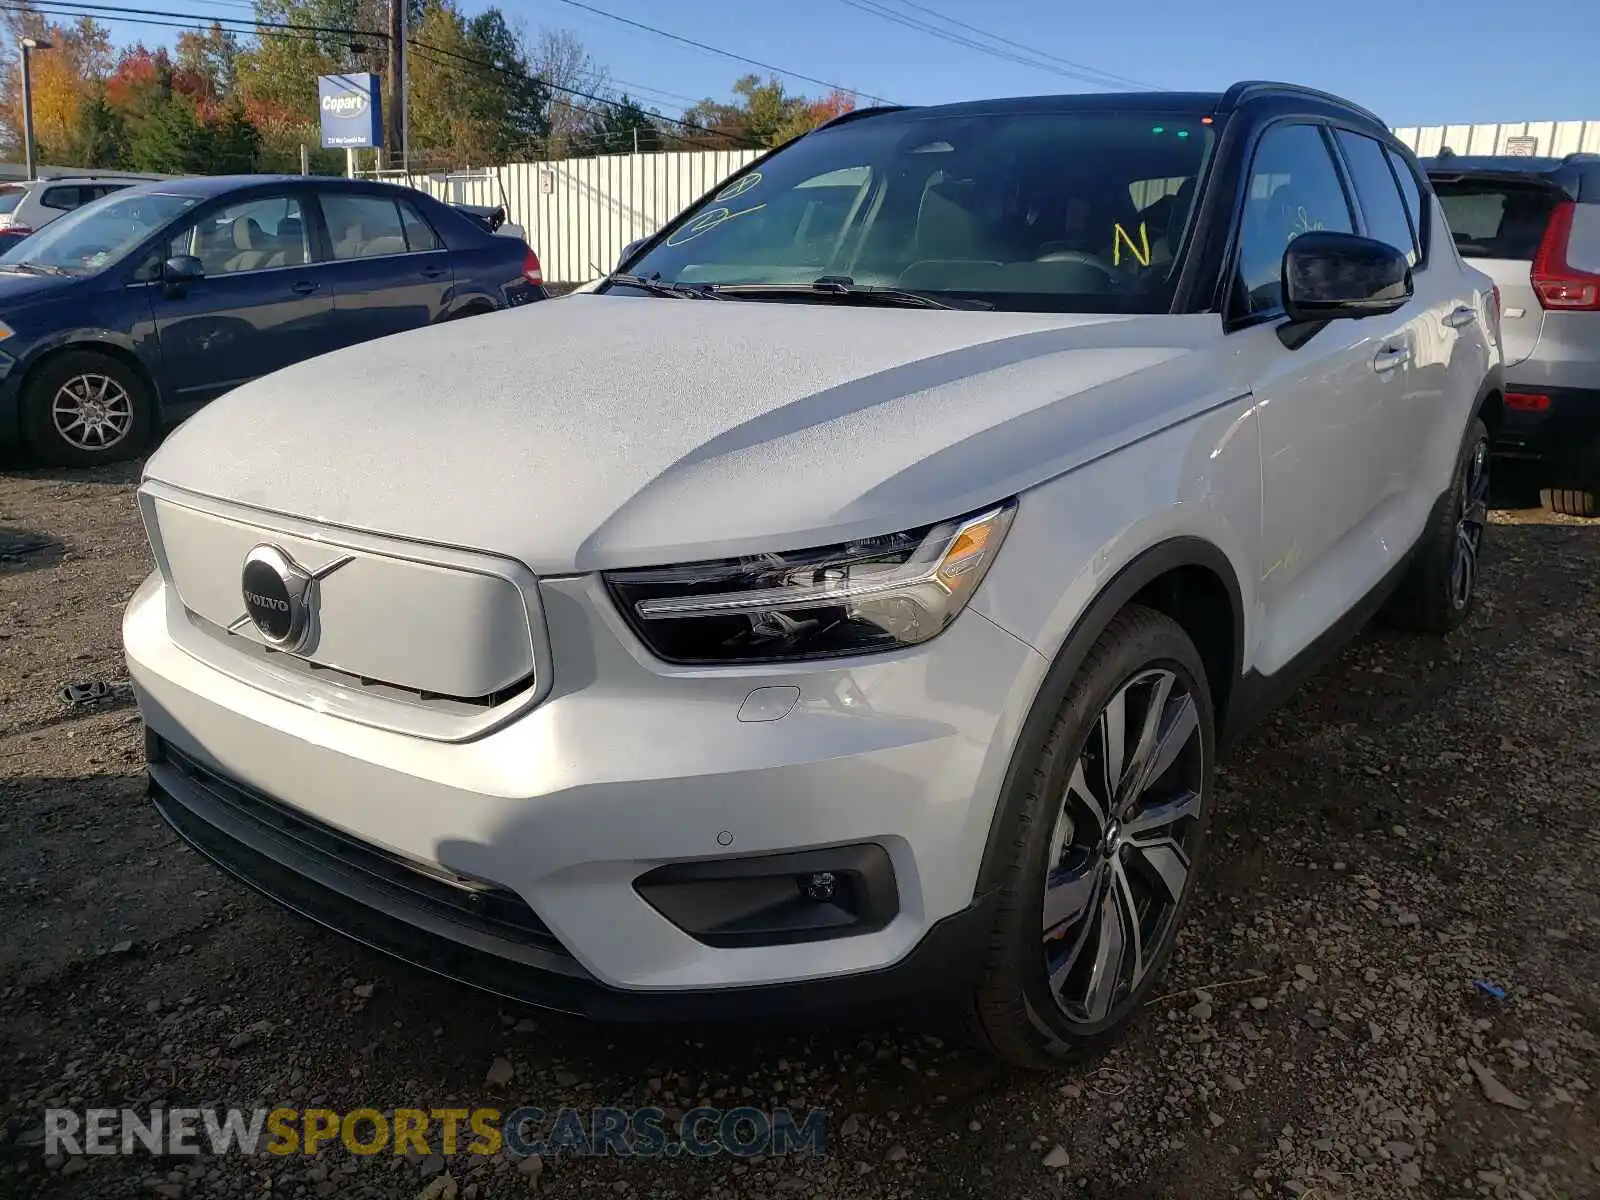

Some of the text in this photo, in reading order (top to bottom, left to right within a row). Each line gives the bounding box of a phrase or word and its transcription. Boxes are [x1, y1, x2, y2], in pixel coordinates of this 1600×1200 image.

[322, 95, 362, 112] Copart
[1114, 222, 1150, 266] N
[244, 590, 289, 612] VOLVO
